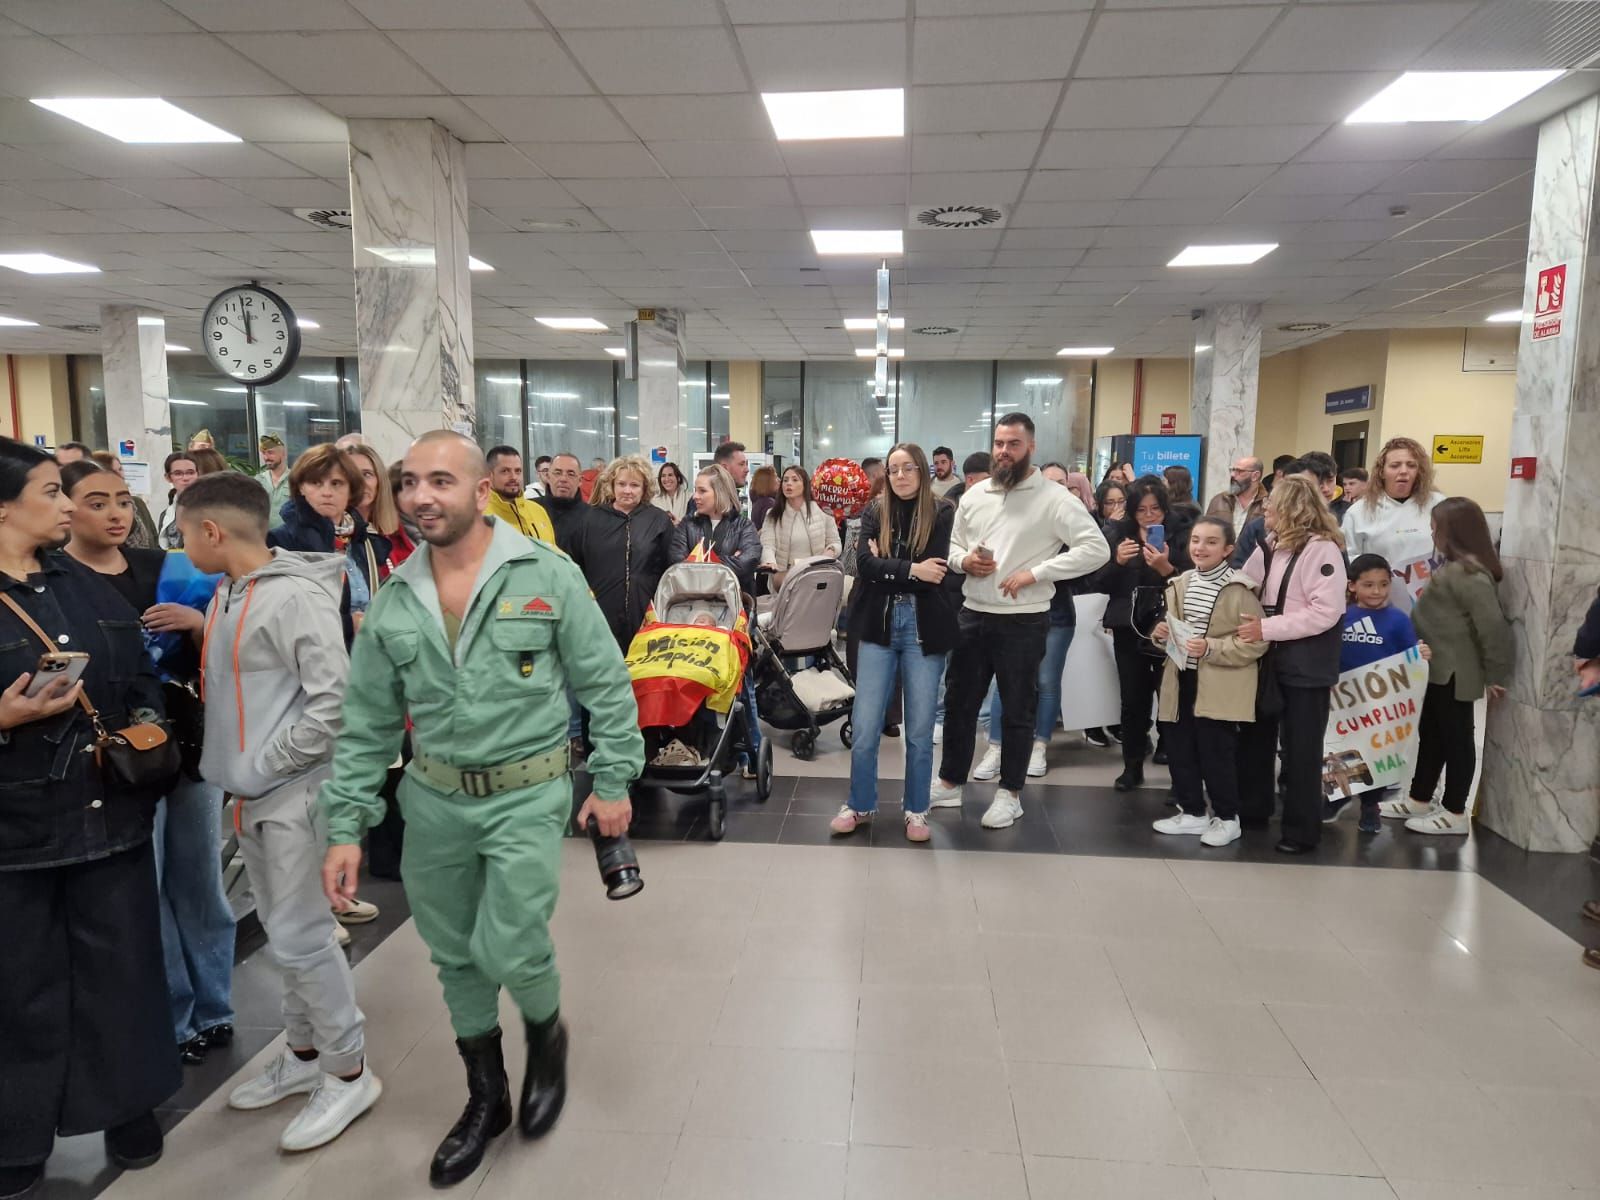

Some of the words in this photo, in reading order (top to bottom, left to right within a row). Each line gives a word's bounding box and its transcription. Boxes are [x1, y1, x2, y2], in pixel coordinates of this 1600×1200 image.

[225, 303, 236, 312] 11
[216, 316, 228, 325] 10
[271, 313, 280, 323] 2
[213, 331, 222, 340] 9
[276, 330, 285, 340] 3
[219, 347, 228, 356] 8
[273, 346, 282, 354] 4
[233, 359, 242, 368] 7
[263, 359, 272, 368] 5
[248, 364, 257, 373] 6
[1142, 451, 1154, 460] Tu
[1157, 451, 1190, 460] billete
[1140, 464, 1154, 472] de
[821, 484, 849, 495] MERRY
[1342, 631, 1384, 645] adidas
[1329, 664, 1411, 712] ISIÓN
[1336, 698, 1417, 735] CUMPLIDA
